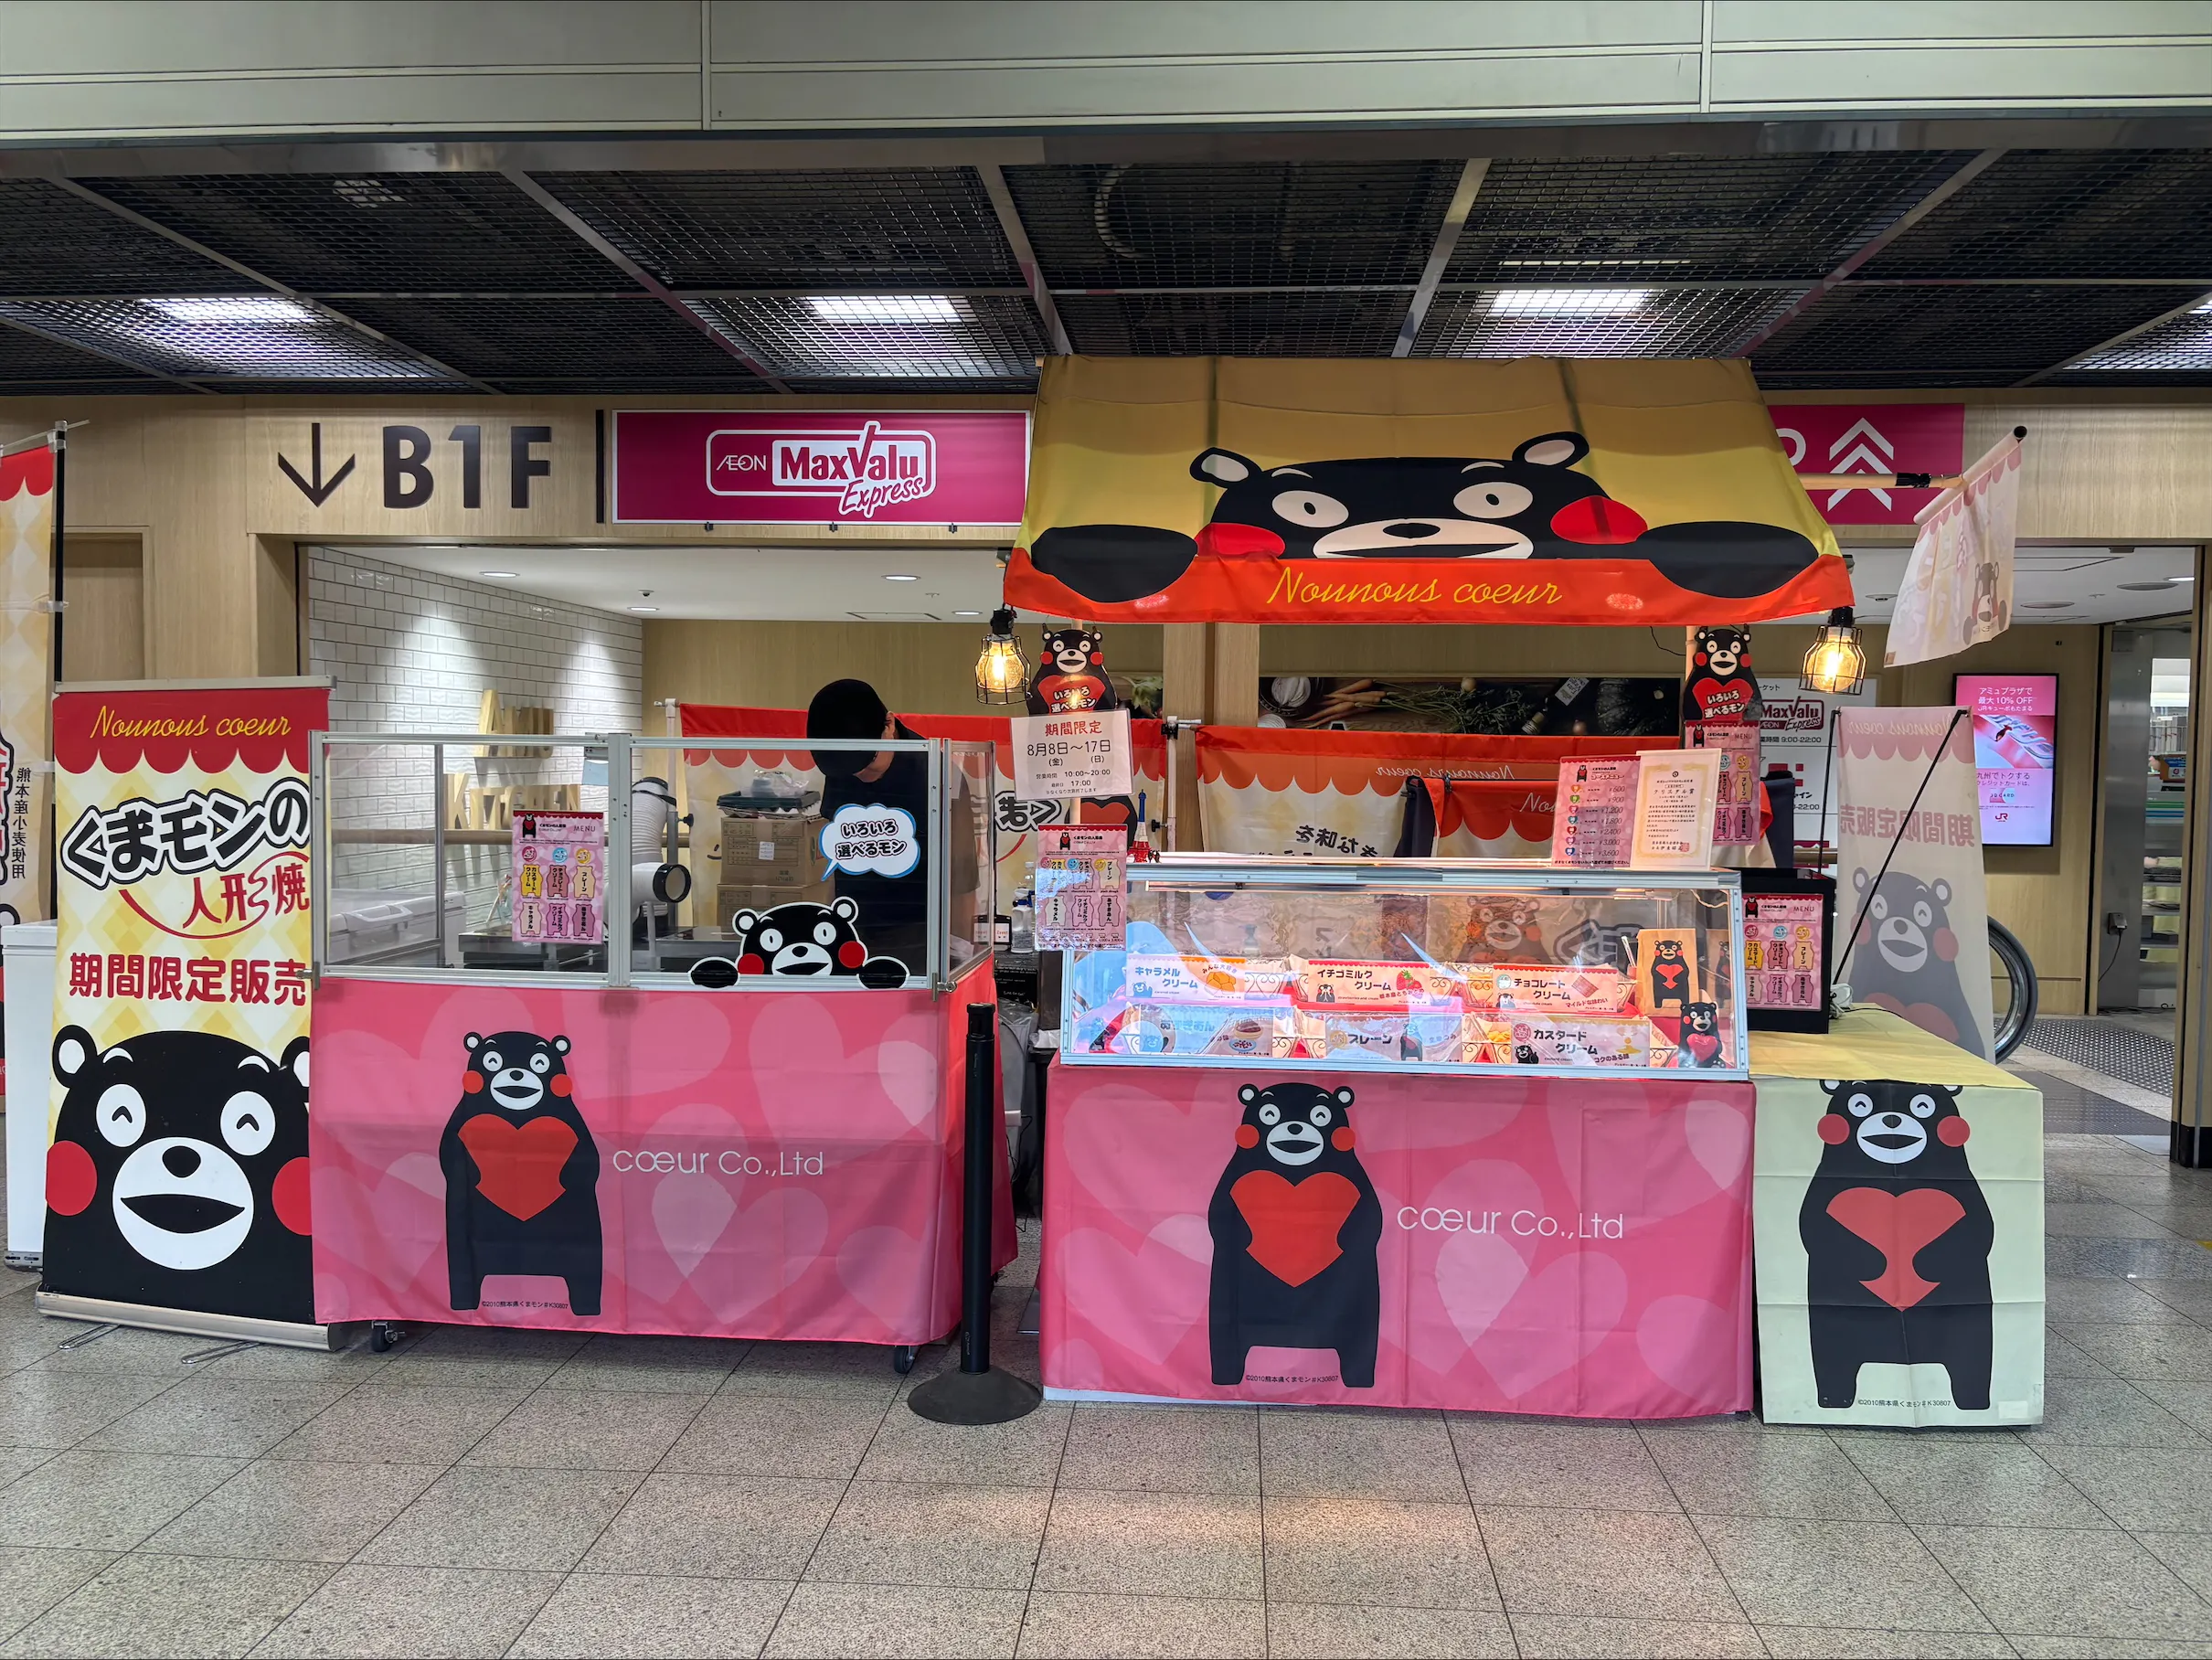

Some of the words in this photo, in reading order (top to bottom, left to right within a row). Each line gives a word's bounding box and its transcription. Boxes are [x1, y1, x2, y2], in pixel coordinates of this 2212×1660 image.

[781, 425, 919, 481] MaxValu
[383, 425, 552, 510] B1F
[842, 477, 923, 514] Express
[1266, 566, 1441, 604] Nounous
[1453, 581, 1563, 604] coeur
[1707, 690, 1740, 704] いろいろ
[1978, 697, 1994, 705] 最大
[2015, 697, 2033, 705] OFF
[1704, 703, 1745, 718] 選べるモン
[1762, 696, 1819, 718] MaxValu
[90, 705, 209, 739] Nounous
[216, 716, 292, 736] coeur
[1045, 720, 1102, 737] 期間限定
[1785, 717, 1821, 731] Express
[1994, 813, 2008, 821] JR
[61, 777, 310, 892] くまモンの
[841, 818, 899, 839] いろいろ
[835, 839, 908, 860] 選べるモン
[182, 862, 311, 930] 人形焼
[69, 952, 306, 1006] 期間限定販売
[1135, 966, 1180, 977] キャラメル
[1317, 969, 1373, 979] イチゴミルク
[1162, 979, 1198, 989] クリーム
[1354, 981, 1391, 991] クリーム
[1514, 978, 1566, 989] チョコレート
[1533, 990, 1571, 1001] クリーム
[1347, 1034, 1392, 1045] プレーン
[1533, 1029, 1587, 1041] カスタード
[1555, 1043, 1598, 1055] クリーム
[718, 1150, 824, 1177] Co.,Ltd
[1511, 1209, 1623, 1240] Co.,Ltd
